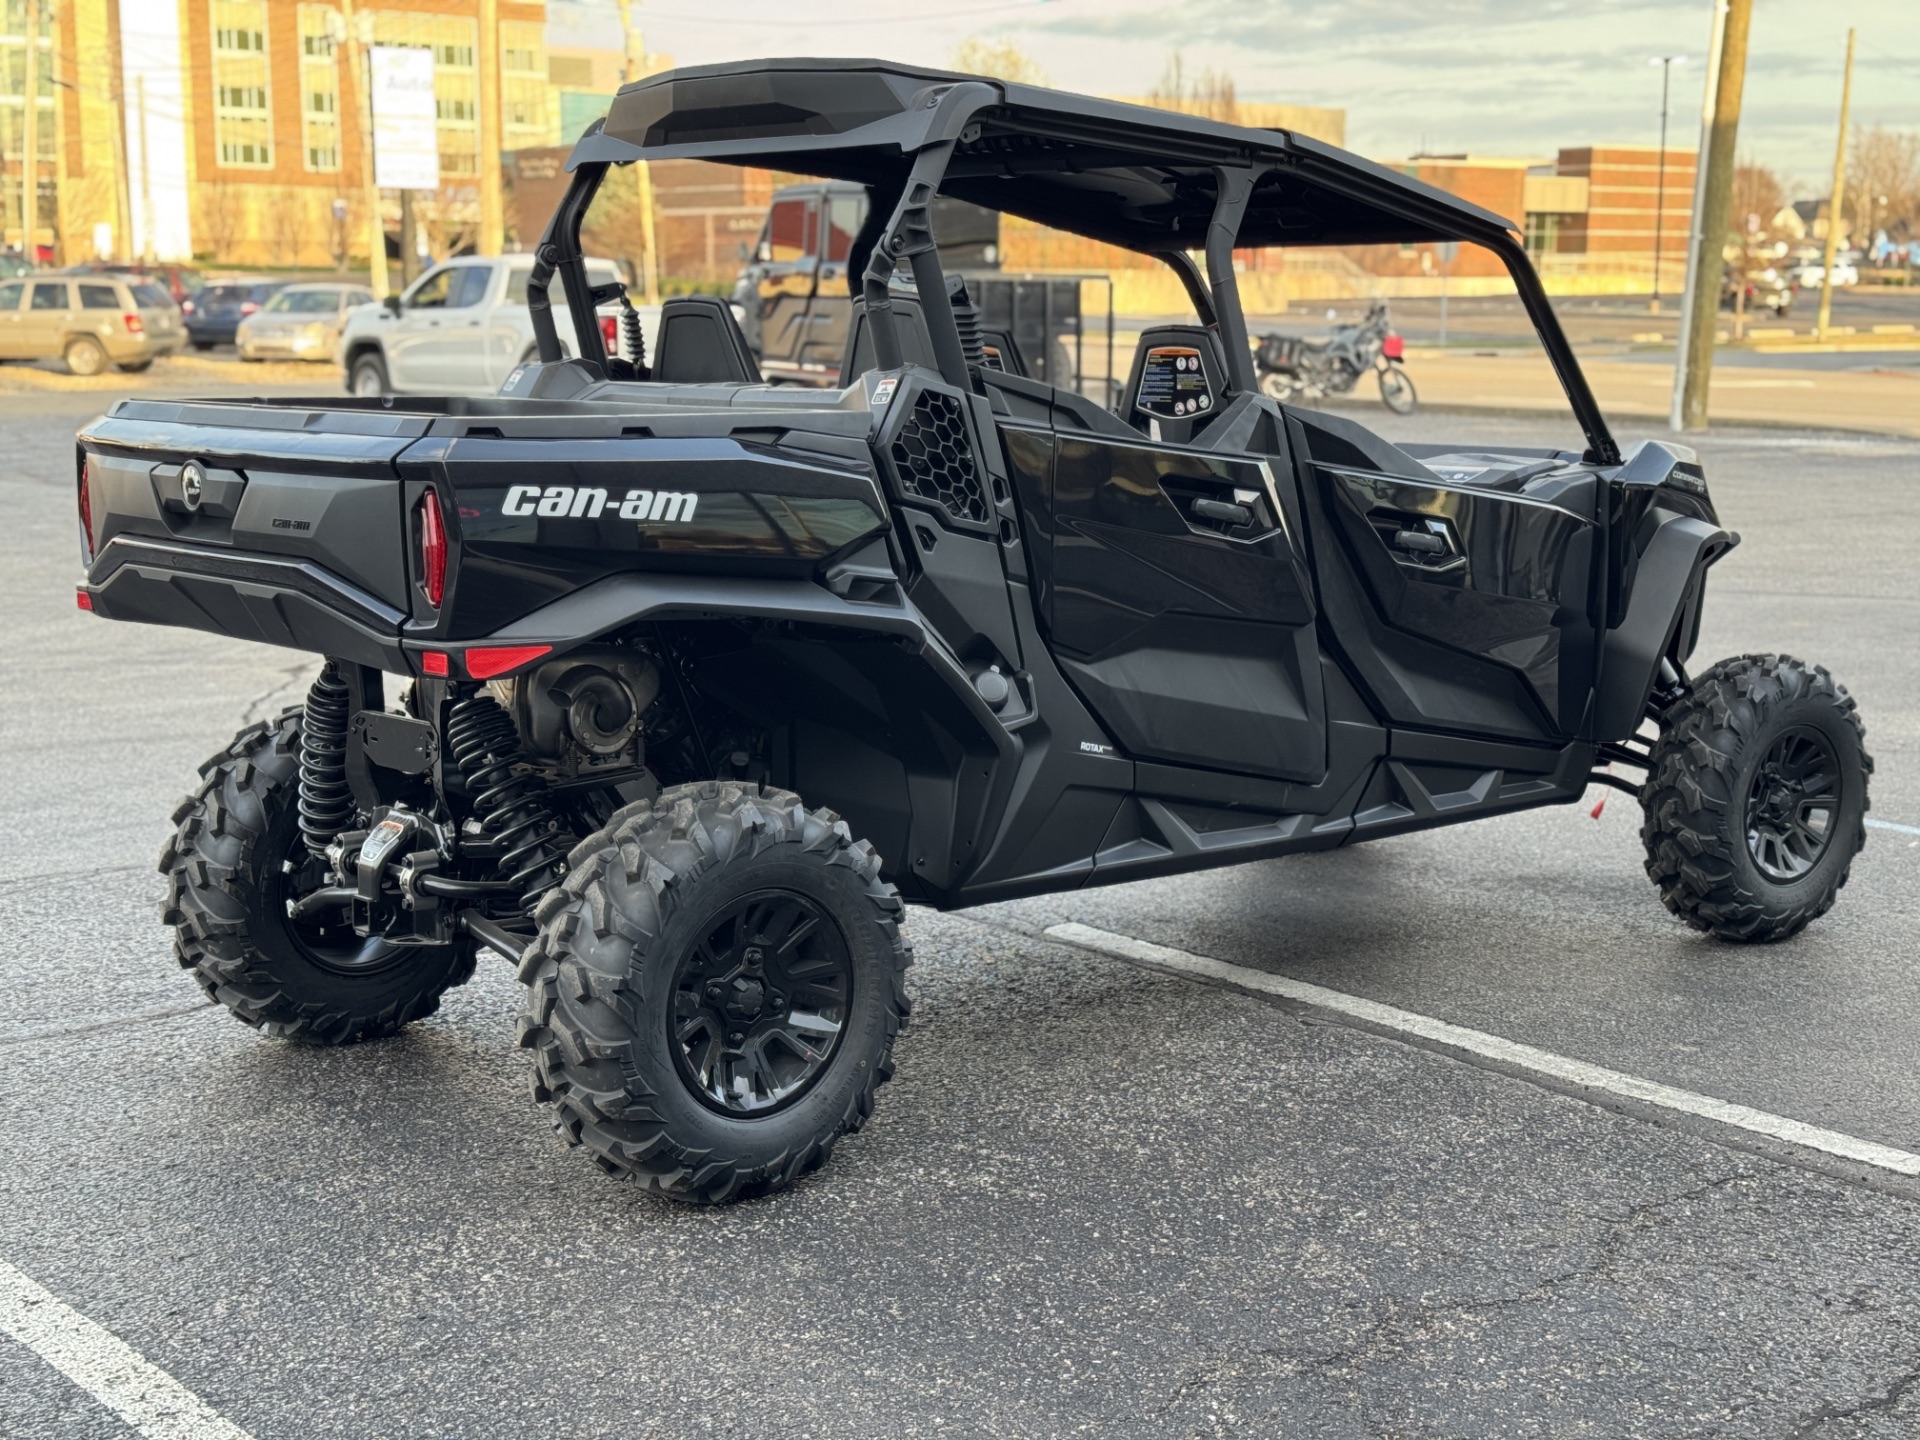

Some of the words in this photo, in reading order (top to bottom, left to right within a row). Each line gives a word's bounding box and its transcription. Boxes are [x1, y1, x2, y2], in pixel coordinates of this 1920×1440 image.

[502, 486, 699, 522] can-am
[272, 518, 311, 531] can-am
[1080, 741, 1104, 753] ROTAX
